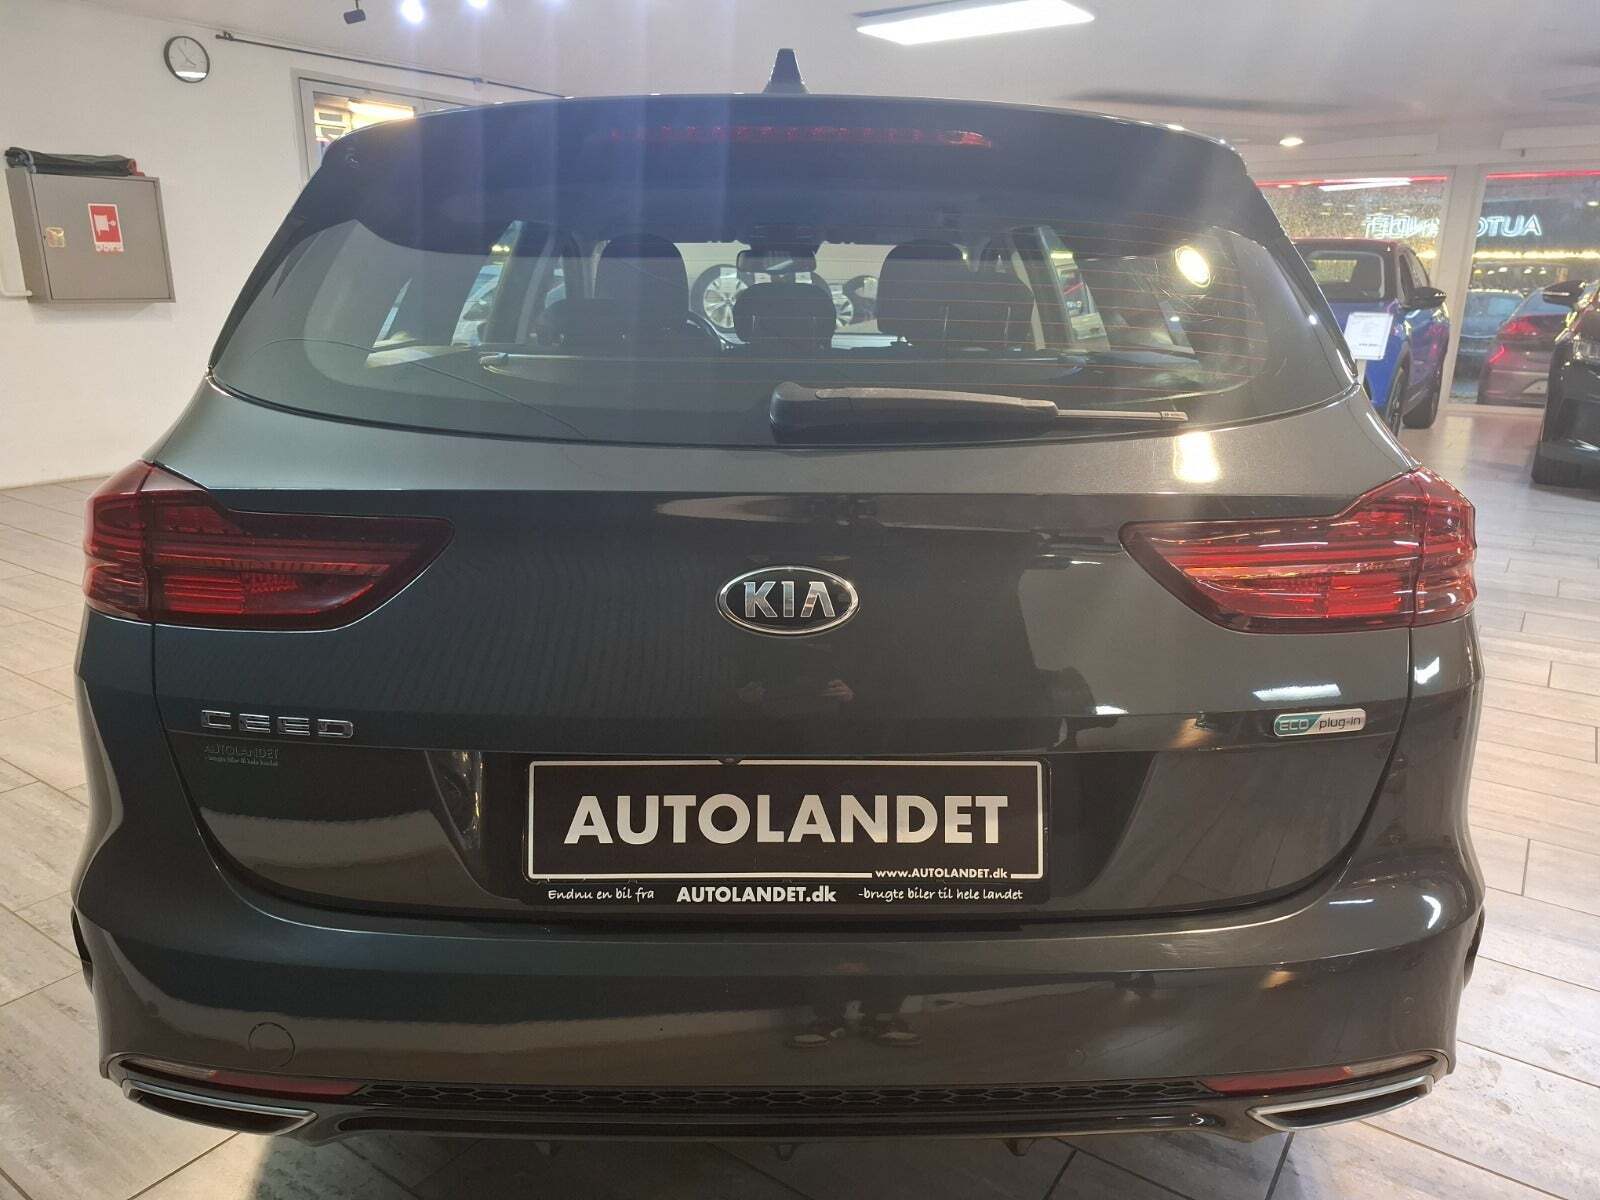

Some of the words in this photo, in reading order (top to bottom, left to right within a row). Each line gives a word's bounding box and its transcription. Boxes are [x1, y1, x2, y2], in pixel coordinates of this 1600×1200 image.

[744, 581, 835, 618] KIA
[201, 709, 354, 738] CEED
[1279, 719, 1309, 731] ECO
[1319, 716, 1361, 730] plug-in
[564, 794, 1008, 844] AUTOLANDET
[875, 867, 1008, 879] www.AUTOLANDET.dk
[548, 888, 593, 900] Endnu
[597, 890, 612, 900] en
[616, 886, 632, 900] bil
[635, 886, 655, 903] fra
[676, 885, 837, 903] AUTOLANDET.dk
[908, 886, 936, 900] biler
[938, 886, 953, 899] til
[956, 887, 980, 900] hele
[983, 888, 1023, 900] landet
